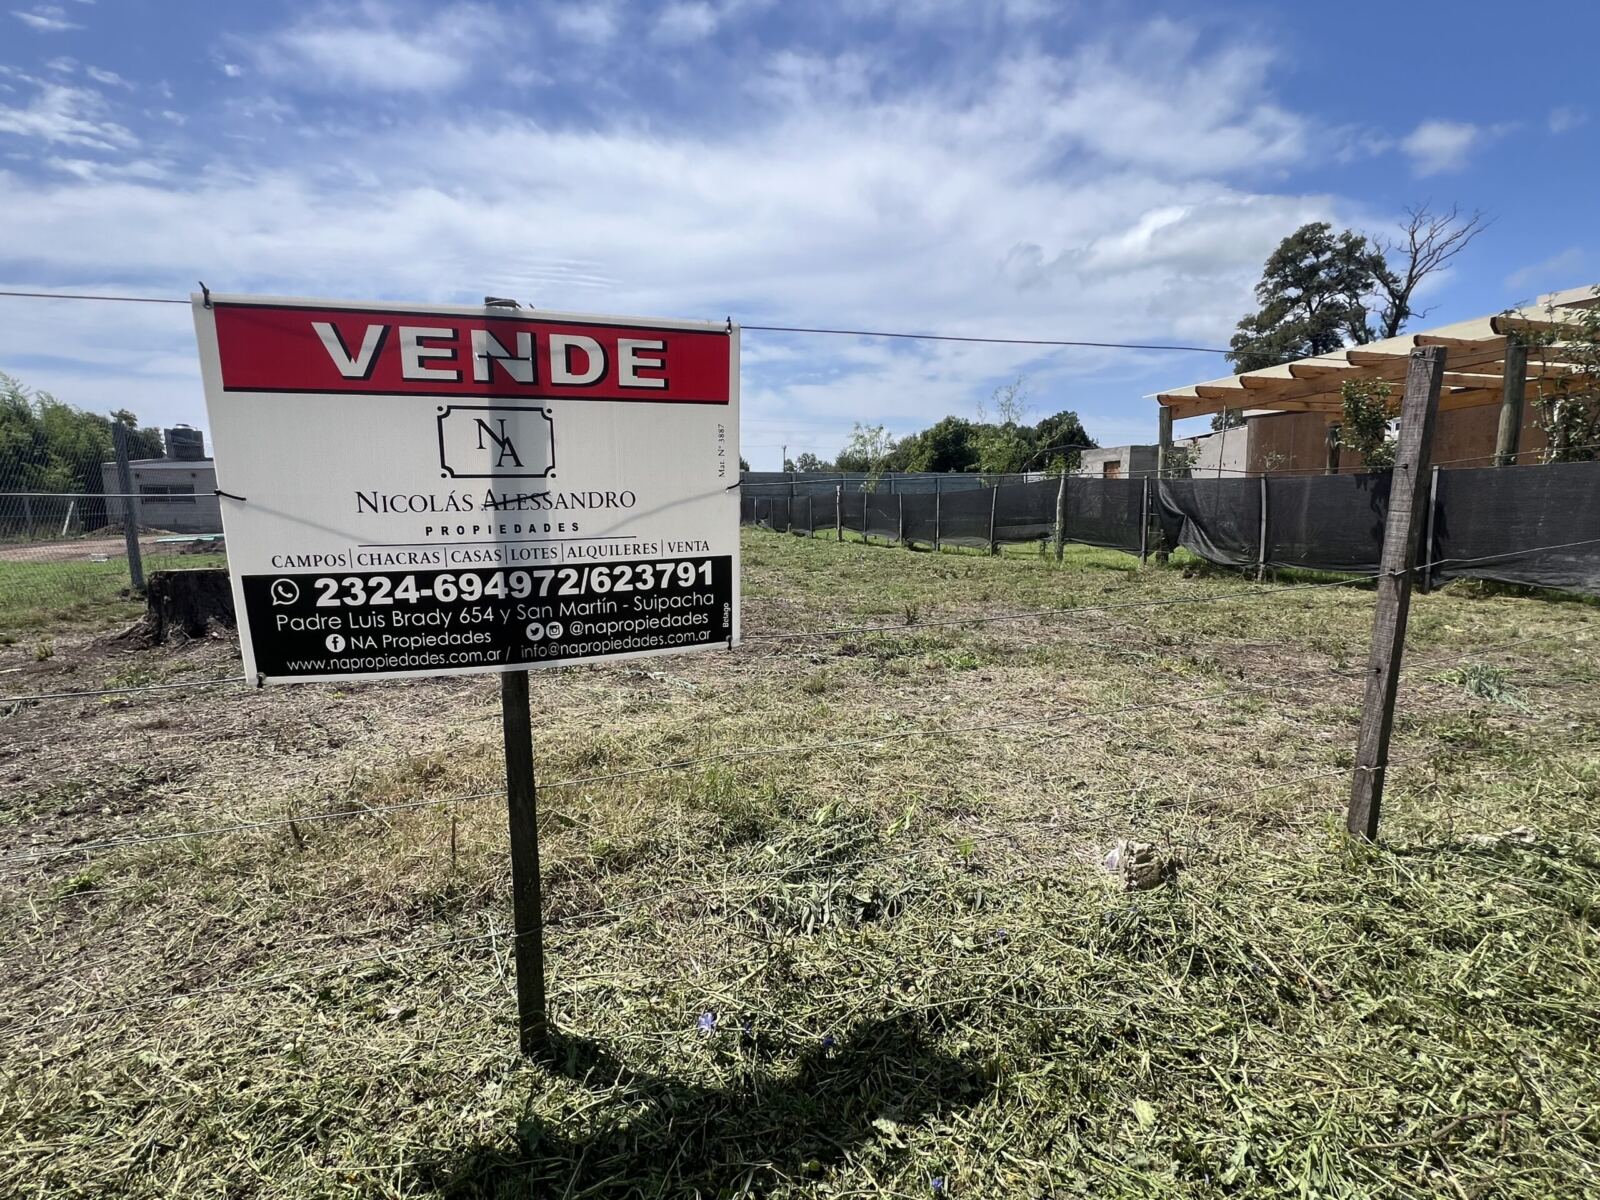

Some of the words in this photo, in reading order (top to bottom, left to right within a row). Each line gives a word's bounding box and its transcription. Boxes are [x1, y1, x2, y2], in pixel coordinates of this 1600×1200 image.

[310, 320, 669, 390] VENDE
[481, 488, 637, 512] ALESSANDRO
[425, 521, 580, 537] PROPIEDADES
[271, 553, 347, 569] CAMPOS
[356, 551, 441, 567] CHACRAS
[450, 549, 503, 564] CASAS
[510, 546, 558, 561] LOTES
[567, 542, 658, 560] ALQUILERES
[667, 540, 710, 553] VENTA
[313, 560, 713, 608] 2324-694972/623791
[276, 612, 342, 632] Padre
[348, 610, 386, 630] Luis
[392, 608, 452, 628] Brady
[459, 606, 494, 624] 654
[499, 607, 511, 624] y
[516, 604, 553, 620] San
[559, 596, 617, 617] Martín
[633, 590, 715, 613] Suipacha
[569, 611, 709, 636] @napropiedades
[286, 648, 502, 672] www.napropiedades.com.ar
[520, 628, 711, 660] info@napropiedades.com.ar
[350, 634, 378, 650] NA
[382, 631, 492, 651] Propiedades
